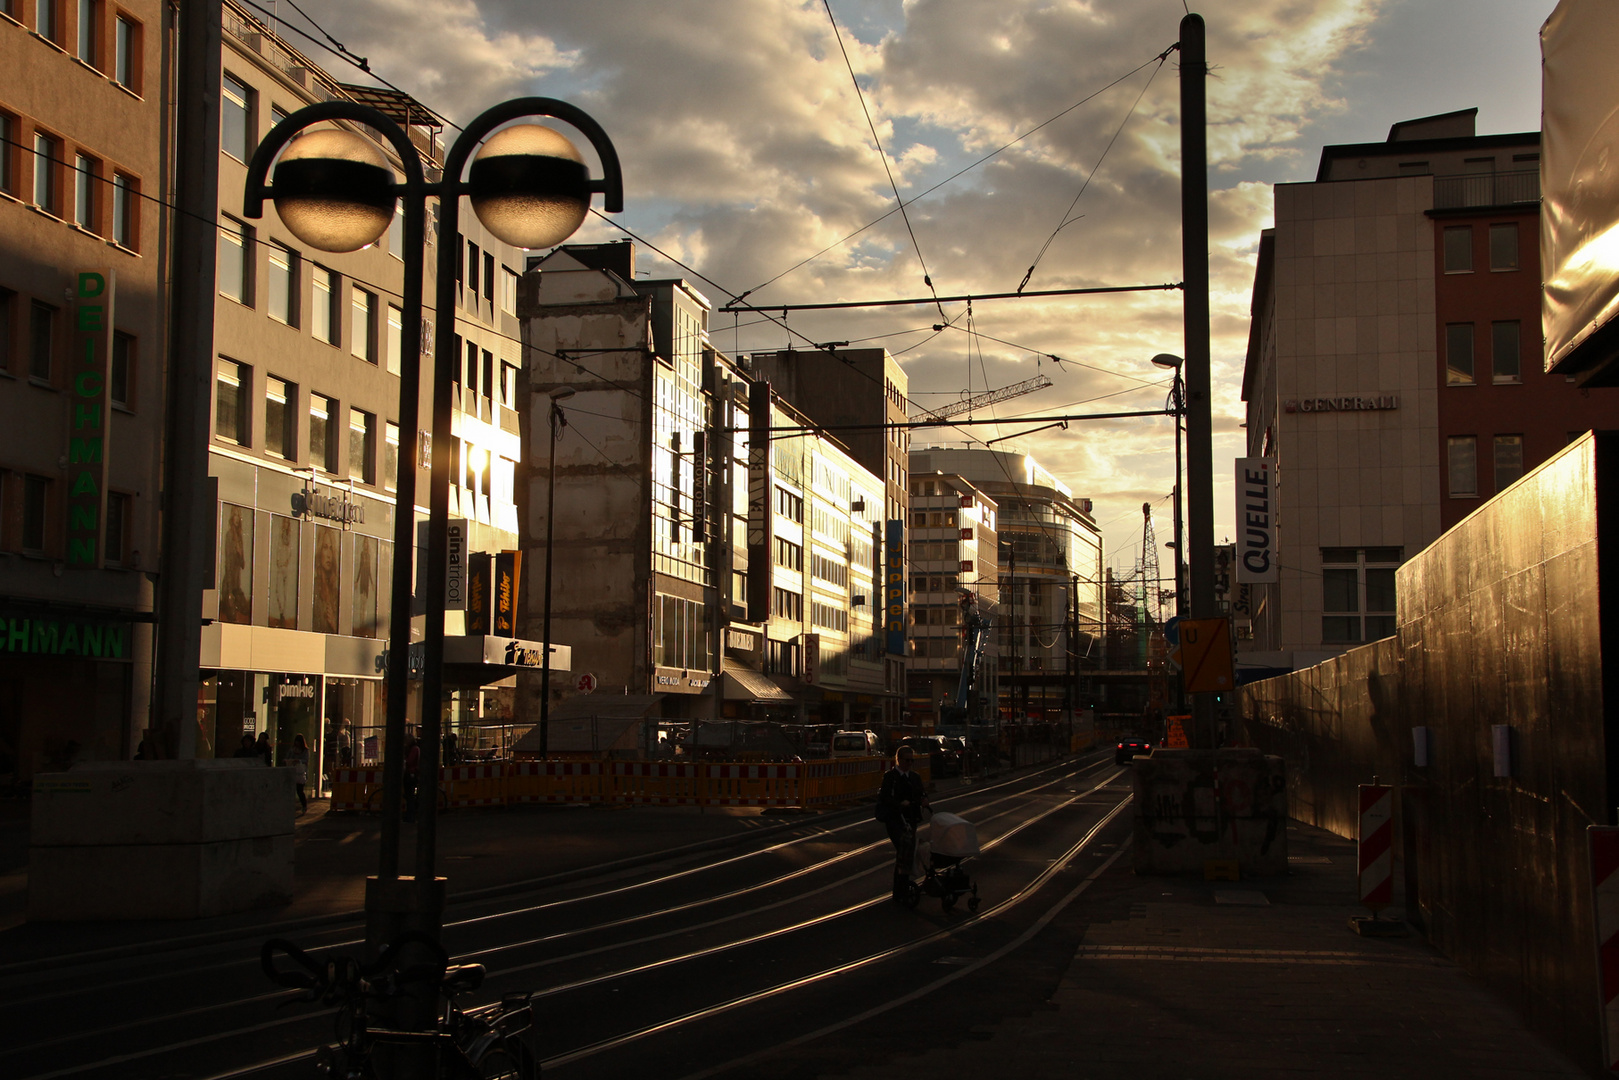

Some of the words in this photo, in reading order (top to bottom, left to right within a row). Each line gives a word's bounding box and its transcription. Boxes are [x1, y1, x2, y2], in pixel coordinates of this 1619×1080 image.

[69, 272, 105, 564] DEICHMANN
[1300, 396, 1397, 412] GENERALI
[695, 451, 703, 487] MODA
[695, 490, 703, 524] VERO
[1243, 463, 1270, 574] QUELLE.
[499, 570, 511, 614] Tchibo
[1185, 628, 1198, 645] U
[805, 635, 818, 684] orsay
[279, 680, 315, 702] pimkie
